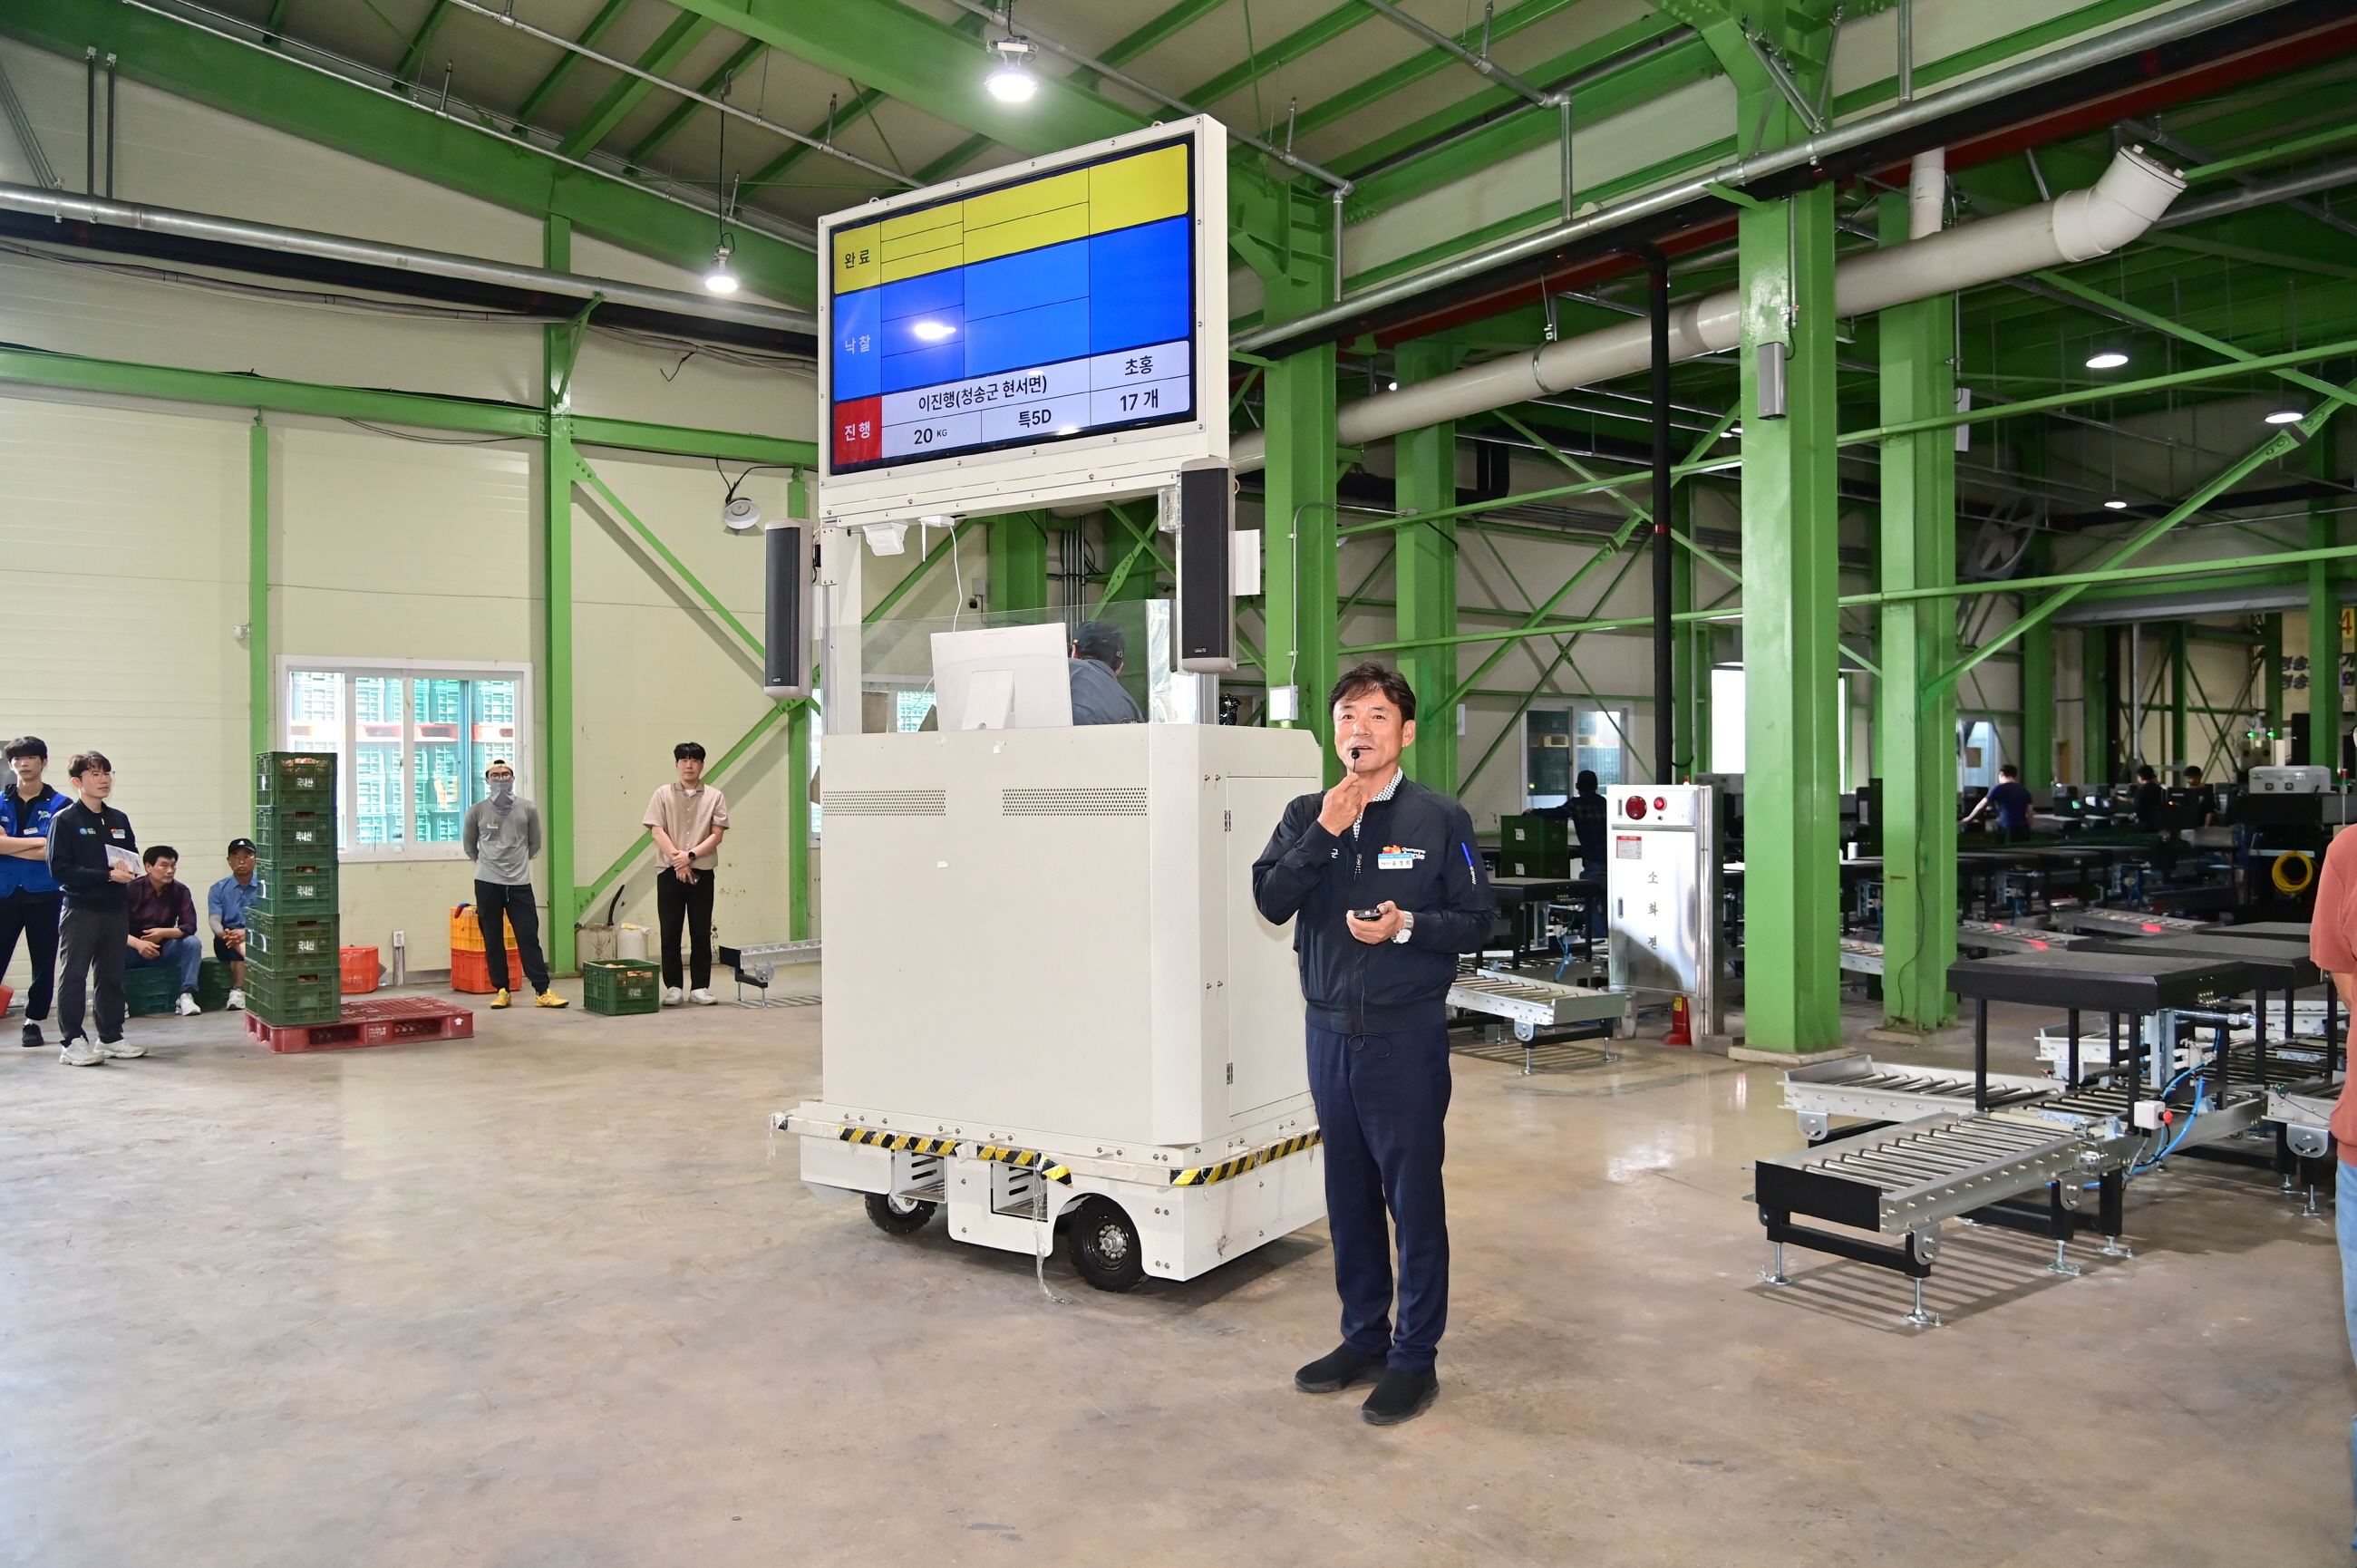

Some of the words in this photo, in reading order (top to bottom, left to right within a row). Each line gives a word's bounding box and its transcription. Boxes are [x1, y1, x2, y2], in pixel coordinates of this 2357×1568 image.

[1124, 354, 1154, 376] 초홍
[918, 383, 998, 412] 이진행(청송군
[1120, 393, 1139, 411] 17
[1143, 388, 1159, 409] 개
[1018, 409, 1052, 429] 특5D
[914, 428, 933, 445] 20
[936, 429, 948, 438] KG
[296, 777, 314, 788] 국내산
[296, 831, 313, 842] 국내산
[296, 885, 314, 896] 국내산
[297, 940, 315, 952] 국내산
